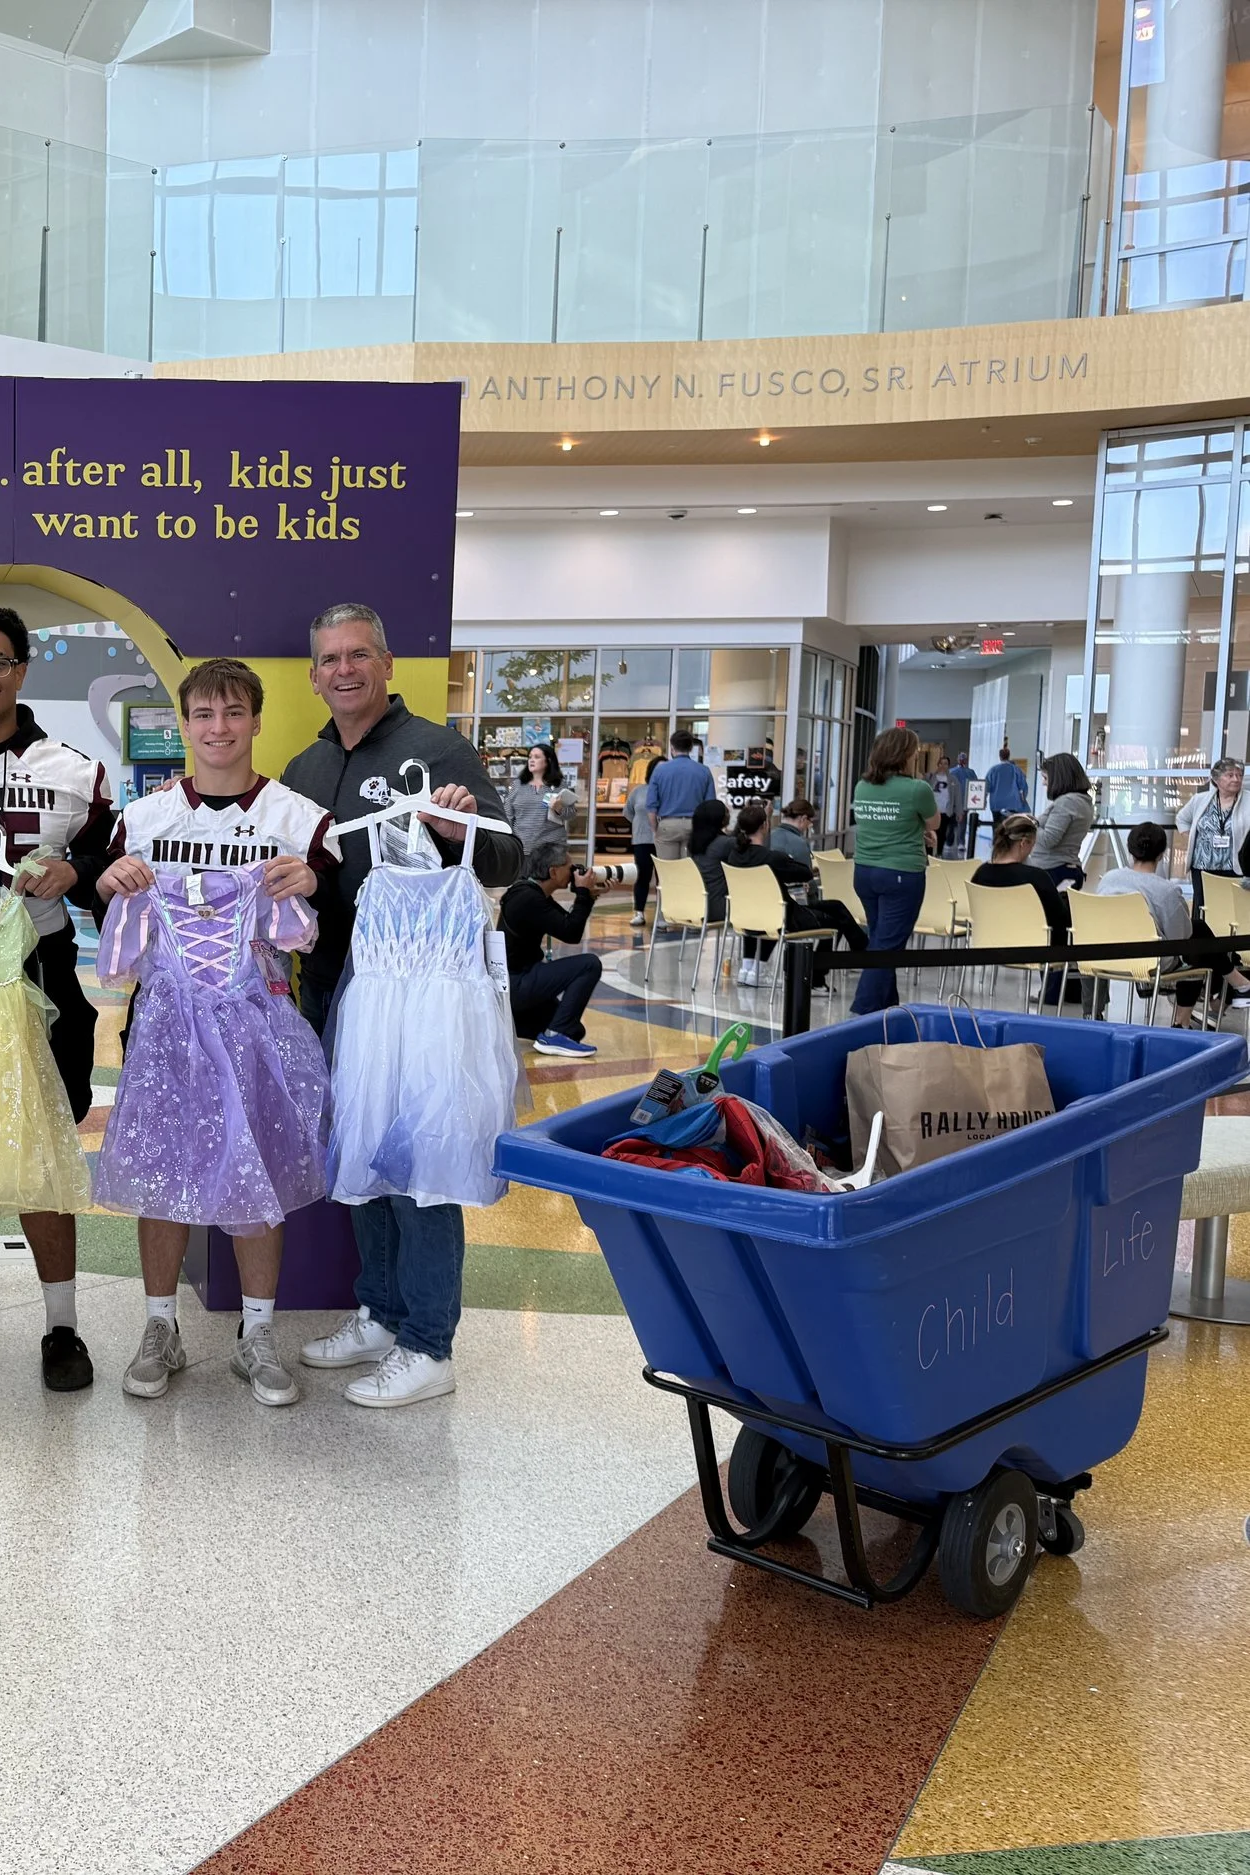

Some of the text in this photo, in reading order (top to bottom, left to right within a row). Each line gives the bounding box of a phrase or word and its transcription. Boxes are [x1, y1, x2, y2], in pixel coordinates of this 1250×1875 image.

[479, 352, 1089, 402] ANTHONY N. FUSCO, SR. ATRIUM
[22, 446, 126, 487] after
[140, 449, 203, 494] all,
[228, 450, 313, 489] kids
[321, 456, 407, 501] just
[32, 503, 361, 541] want to be kids
[717, 773, 772, 792] Safety
[970, 784, 983, 792] Exit
[873, 813, 896, 821] Center
[920, 1111, 990, 1139] RALLY
[918, 1210, 1155, 1370] Child Life
